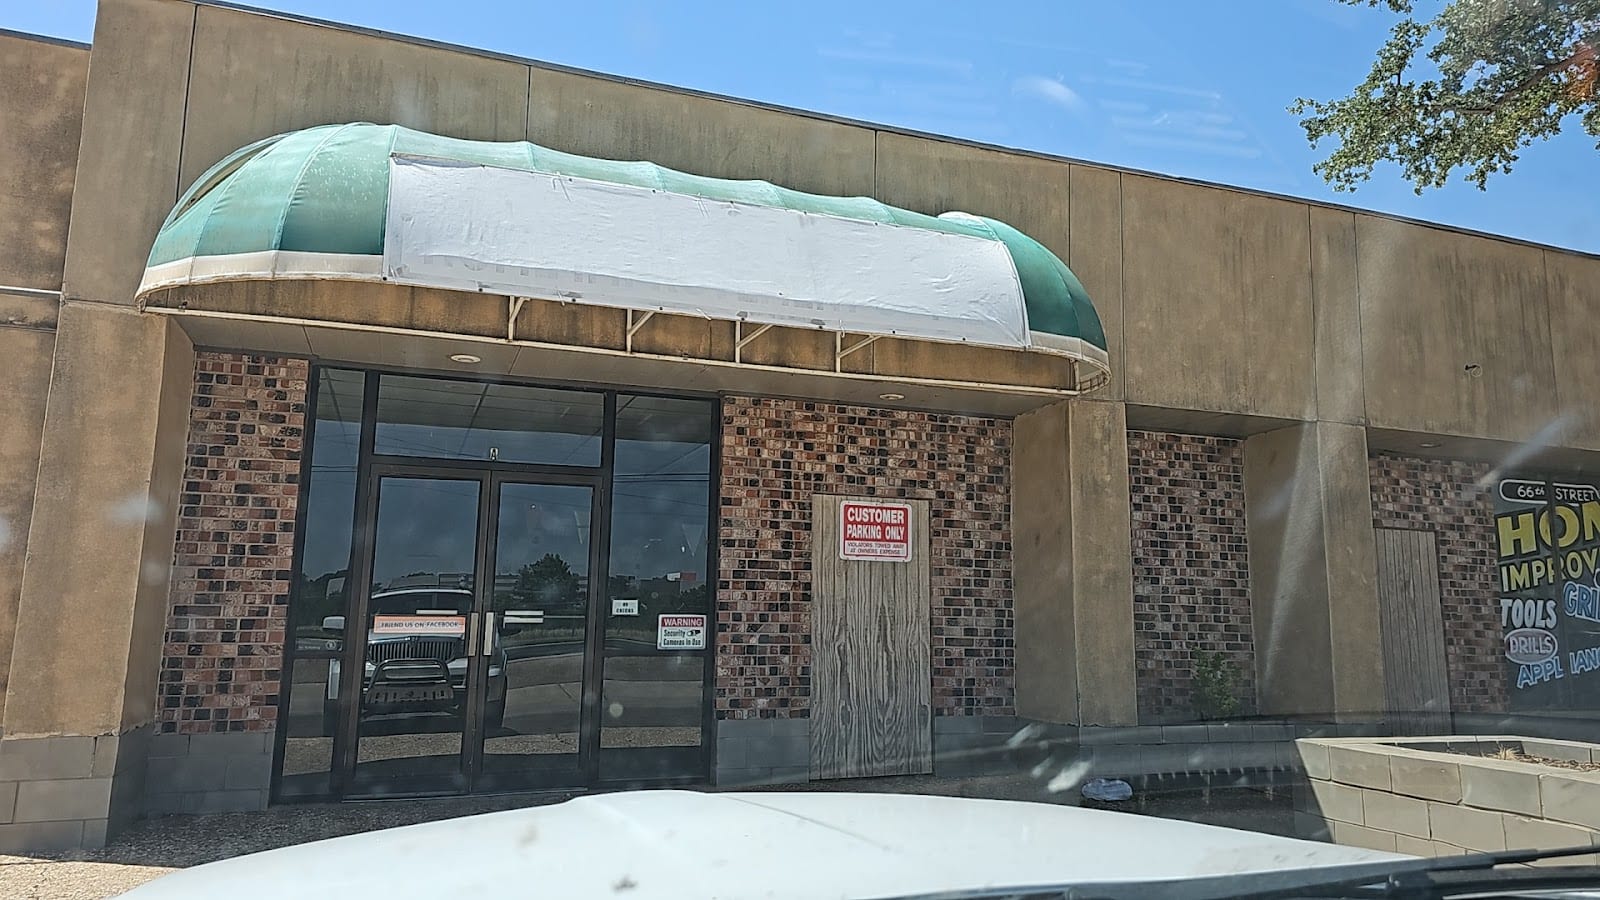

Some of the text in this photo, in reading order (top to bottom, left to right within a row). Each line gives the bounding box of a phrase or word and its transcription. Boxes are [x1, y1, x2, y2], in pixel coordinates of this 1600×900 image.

[1517, 485, 1594, 501] 66th STREET
[847, 507, 905, 524] CUSTOMER
[846, 524, 905, 540] PARKING ONLY
[1500, 598, 1557, 629] TOOLS
[663, 618, 702, 626] WARNING
[664, 629, 686, 637] Security
[663, 638, 684, 646] Cameras
[1509, 636, 1554, 654] DRILLS
